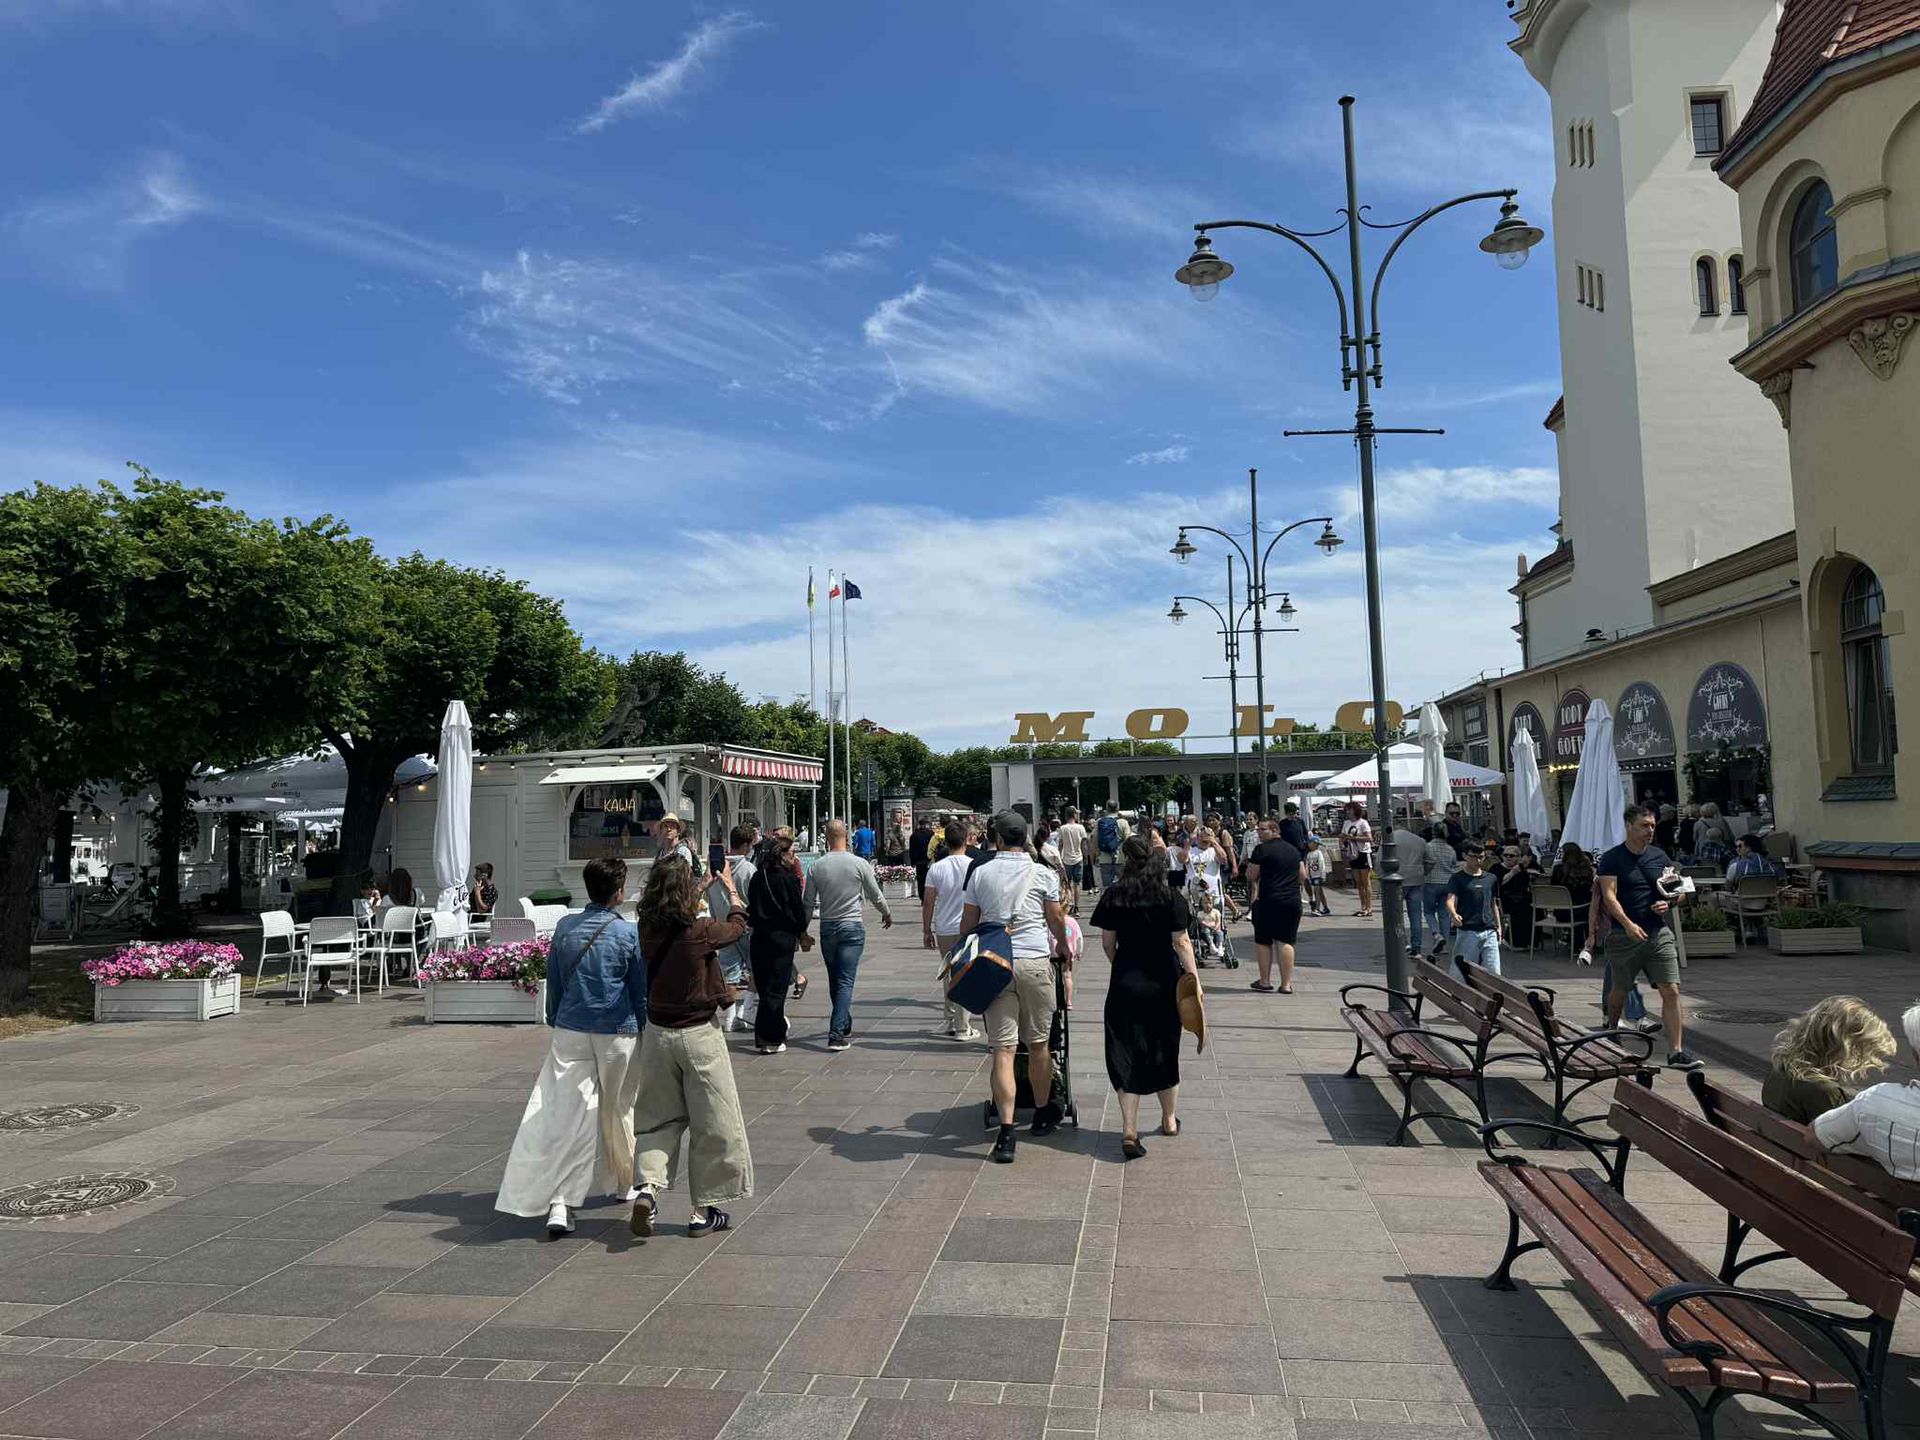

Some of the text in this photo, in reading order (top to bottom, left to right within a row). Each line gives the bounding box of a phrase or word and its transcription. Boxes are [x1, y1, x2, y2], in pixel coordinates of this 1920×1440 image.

[1010, 700, 1403, 743] MOLO
[1561, 704, 1583, 725] LODY
[1557, 736, 1584, 755] GOFR
[603, 798, 636, 812] KAWA
